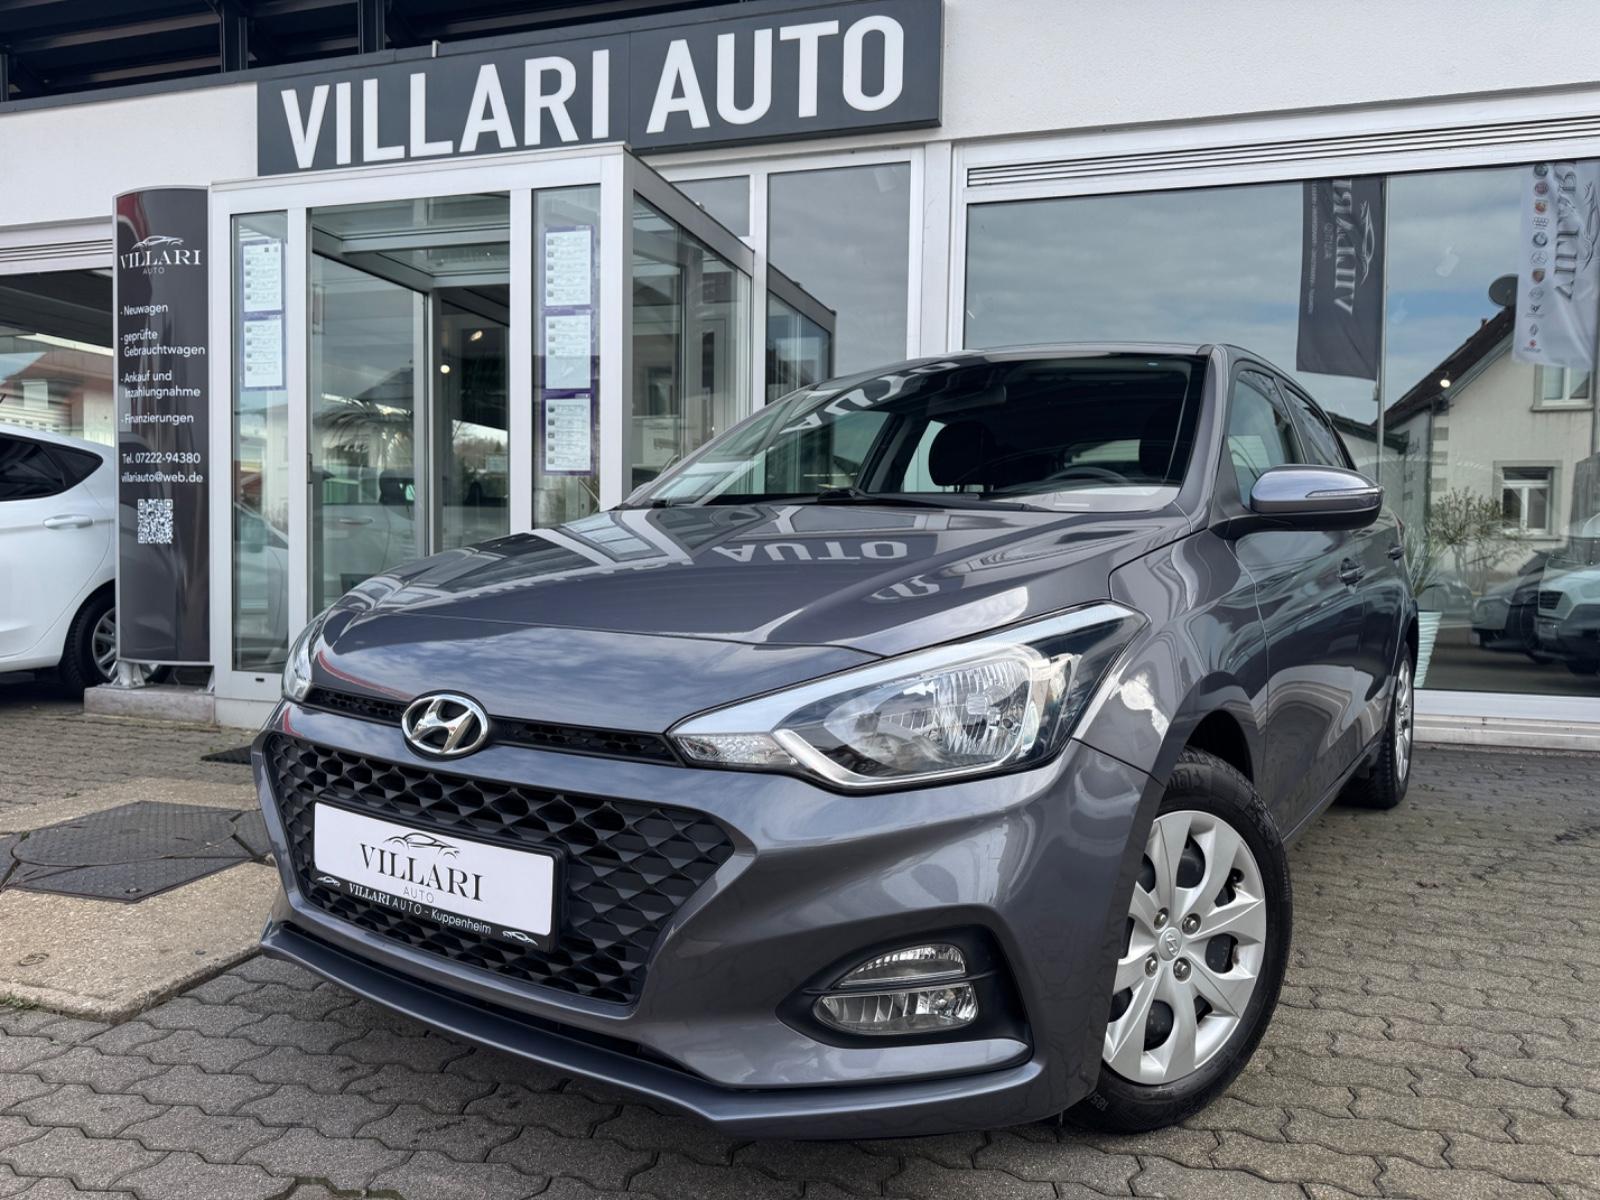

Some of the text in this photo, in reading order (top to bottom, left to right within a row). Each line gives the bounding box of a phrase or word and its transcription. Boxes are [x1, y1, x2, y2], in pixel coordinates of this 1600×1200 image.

[281, 15, 904, 169] VILLARI AUTO
[120, 249, 202, 269] VILLARI
[143, 266, 165, 275] AUTO
[123, 304, 168, 316] Neuwagen
[123, 328, 158, 345] geprüfte
[123, 343, 206, 357] Gebrauchtwagen
[124, 369, 173, 383] Ankauf und
[124, 385, 201, 399] Inzahlungnahme
[124, 412, 194, 426] Finanzierungen
[122, 452, 201, 464] Tel. 07222-94380
[360, 843, 486, 902] VILLARI
[402, 886, 435, 904] AUTO
[348, 882, 391, 906] VILLARI
[391, 899, 422, 915] AUTO
[430, 907, 493, 935] Kuppenheim
